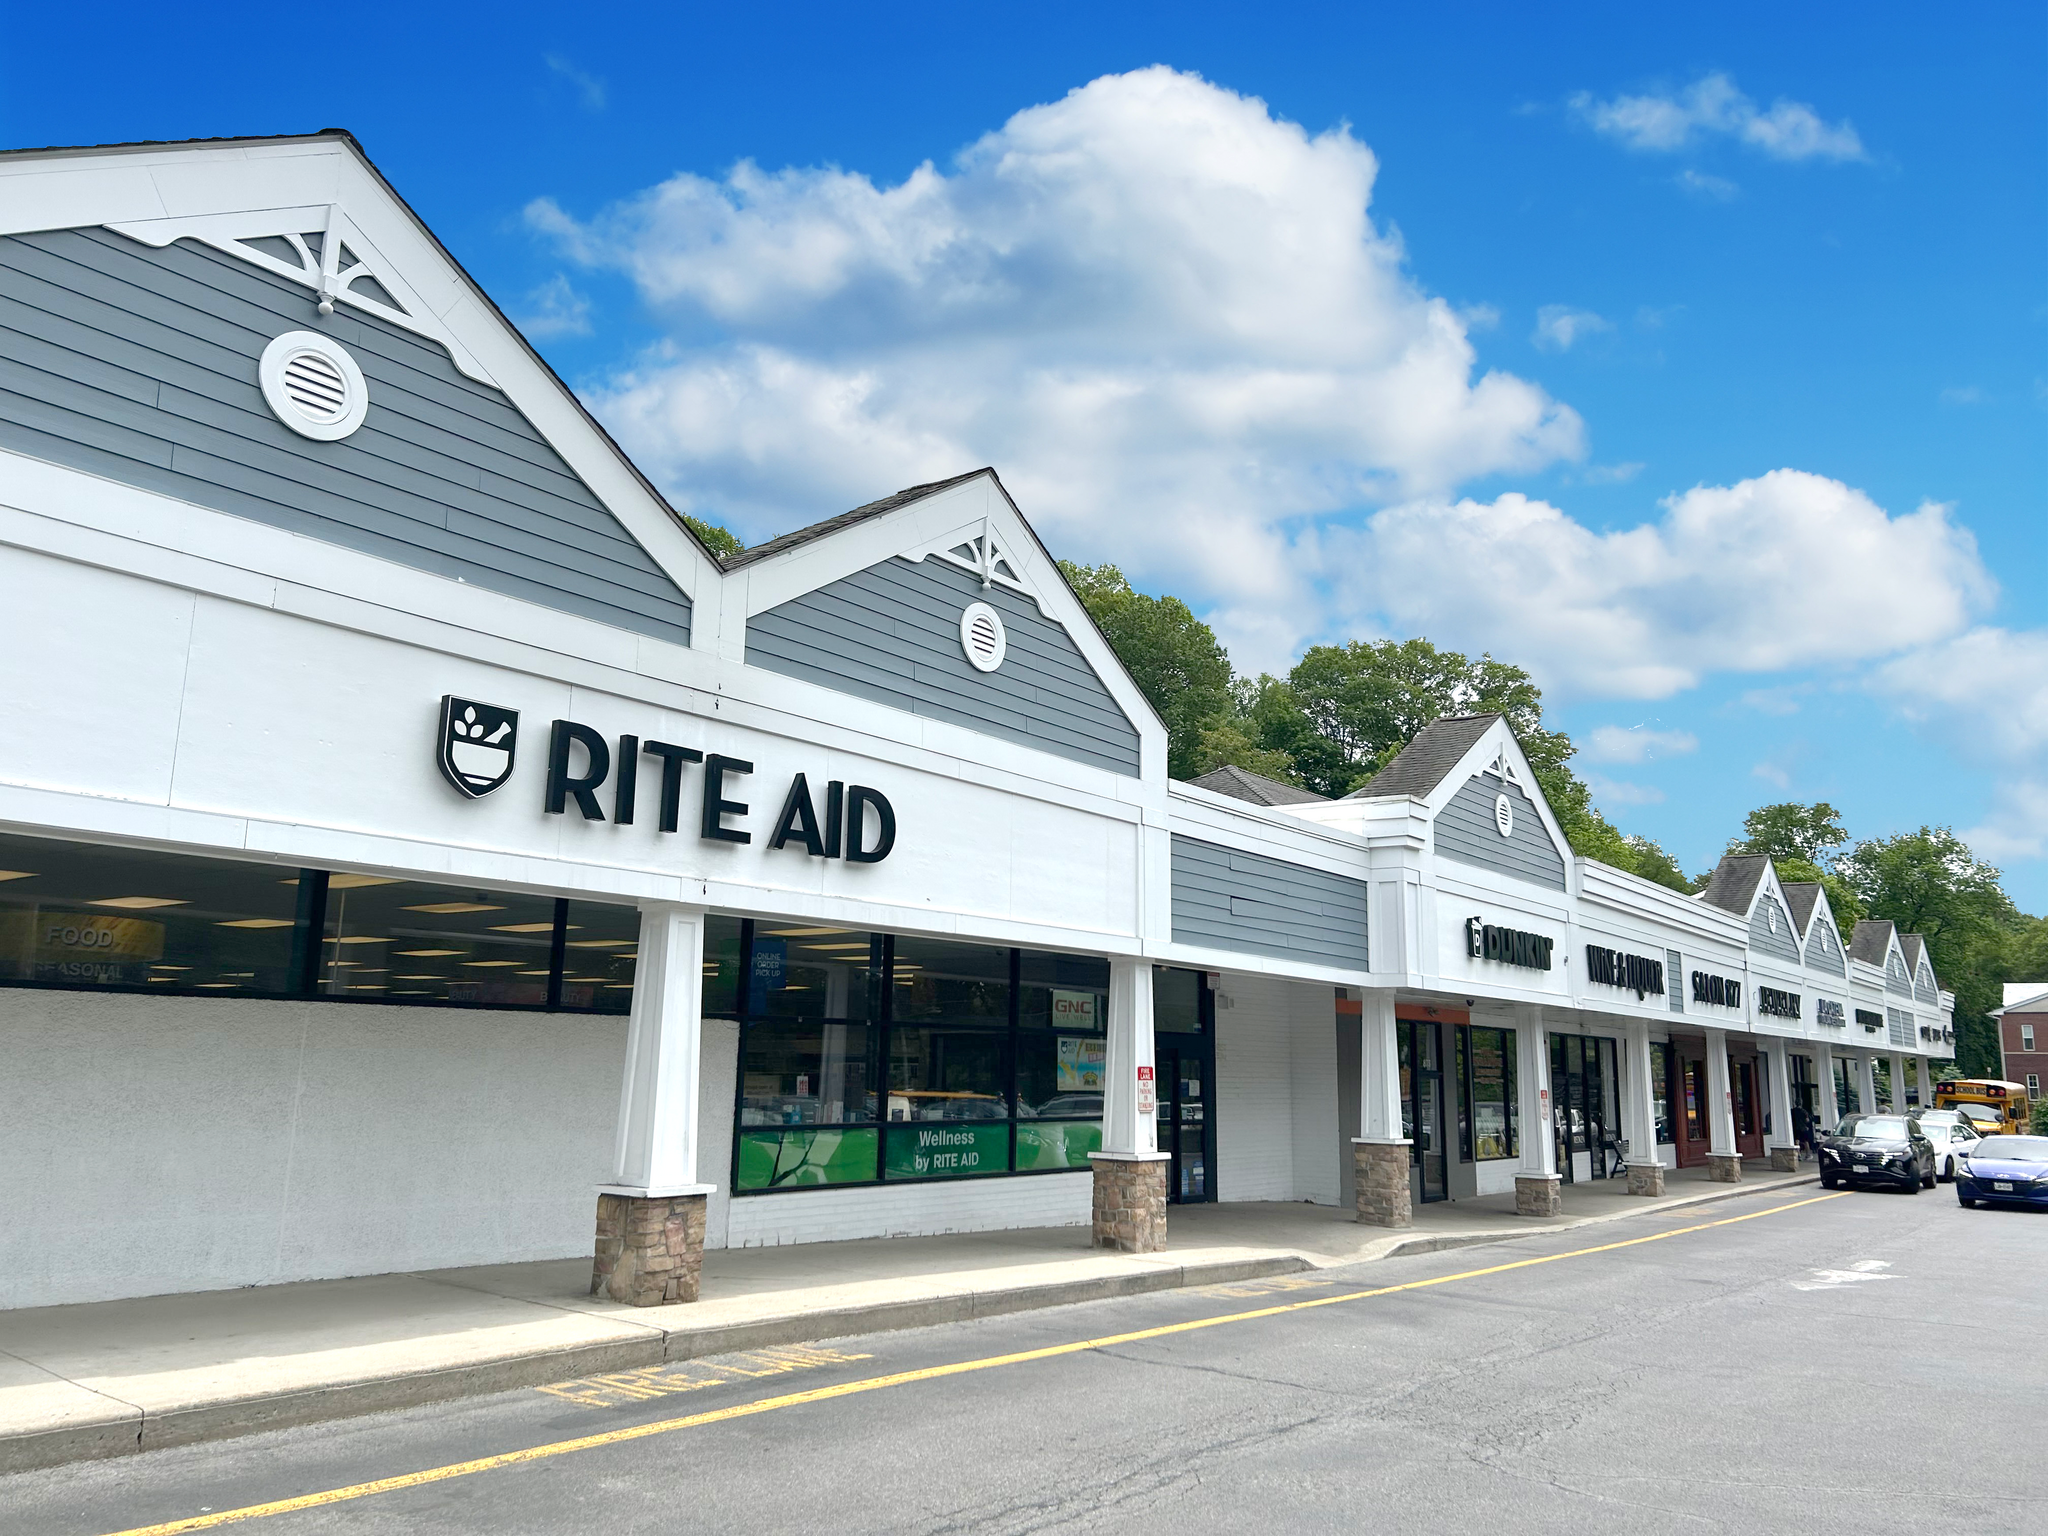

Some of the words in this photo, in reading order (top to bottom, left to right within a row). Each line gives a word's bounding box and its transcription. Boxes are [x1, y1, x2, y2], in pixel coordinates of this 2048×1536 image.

[545, 718, 754, 844] RITE
[767, 772, 897, 864] AID
[45, 925, 114, 947] FOOD
[756, 952, 781, 961] ONLINE
[1483, 924, 1554, 971] DUNKIN'
[755, 969, 771, 977] PICK
[757, 960, 780, 969] ORDER
[1586, 944, 1617, 985] WINE
[1626, 953, 1665, 1001] LIQUOR
[1692, 970, 1725, 1005] SALON
[1055, 999, 1092, 1014] GNC
[1956, 1085, 1976, 1095] SCHOOL
[1976, 1087, 1986, 1096] BUS
[919, 1130, 975, 1147] Wellness
[915, 1154, 930, 1172] by
[933, 1153, 959, 1168] RITE
[960, 1152, 979, 1167] AID
[535, 1366, 726, 1408] FIRE
